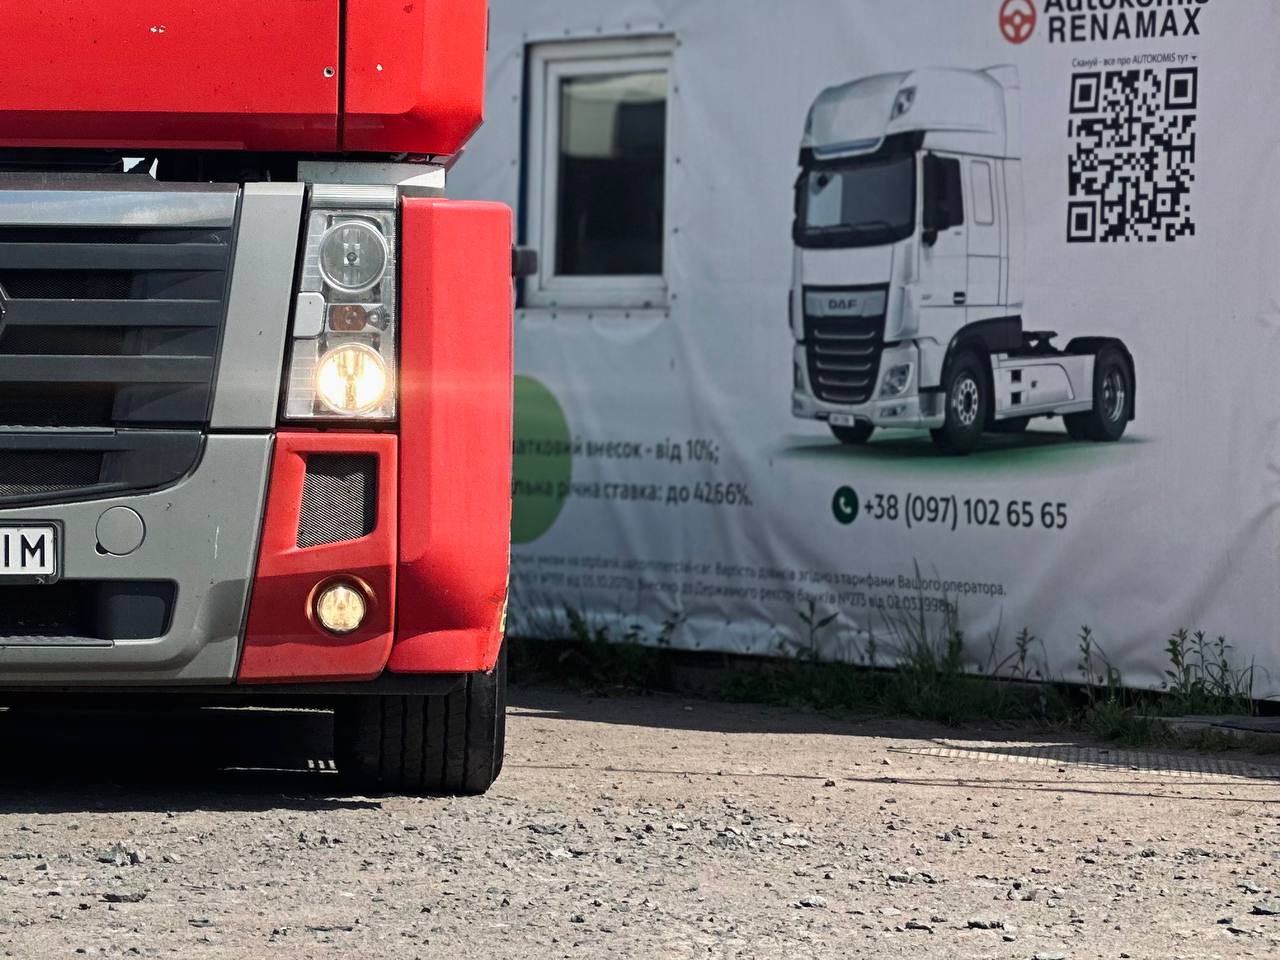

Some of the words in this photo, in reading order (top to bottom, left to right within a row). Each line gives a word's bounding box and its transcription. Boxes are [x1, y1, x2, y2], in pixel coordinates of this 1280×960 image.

[1048, 7, 1201, 44] RENAMAX
[1103, 58, 1116, 66] все
[1117, 57, 1131, 67] про
[1177, 54, 1189, 64] тут
[828, 299, 857, 310] DAF
[586, 440, 642, 459] внесок
[655, 437, 682, 464] від
[686, 439, 720, 465] 10%;
[603, 481, 663, 502] ставка:
[665, 483, 690, 507] до
[864, 494, 899, 520] +38
[905, 492, 958, 531] (097)
[963, 499, 1000, 526] 102
[1006, 500, 1034, 528] 65
[1040, 502, 1068, 529] 65
[898, 575, 940, 591] Вашого
[942, 580, 1007, 597] оператора.
